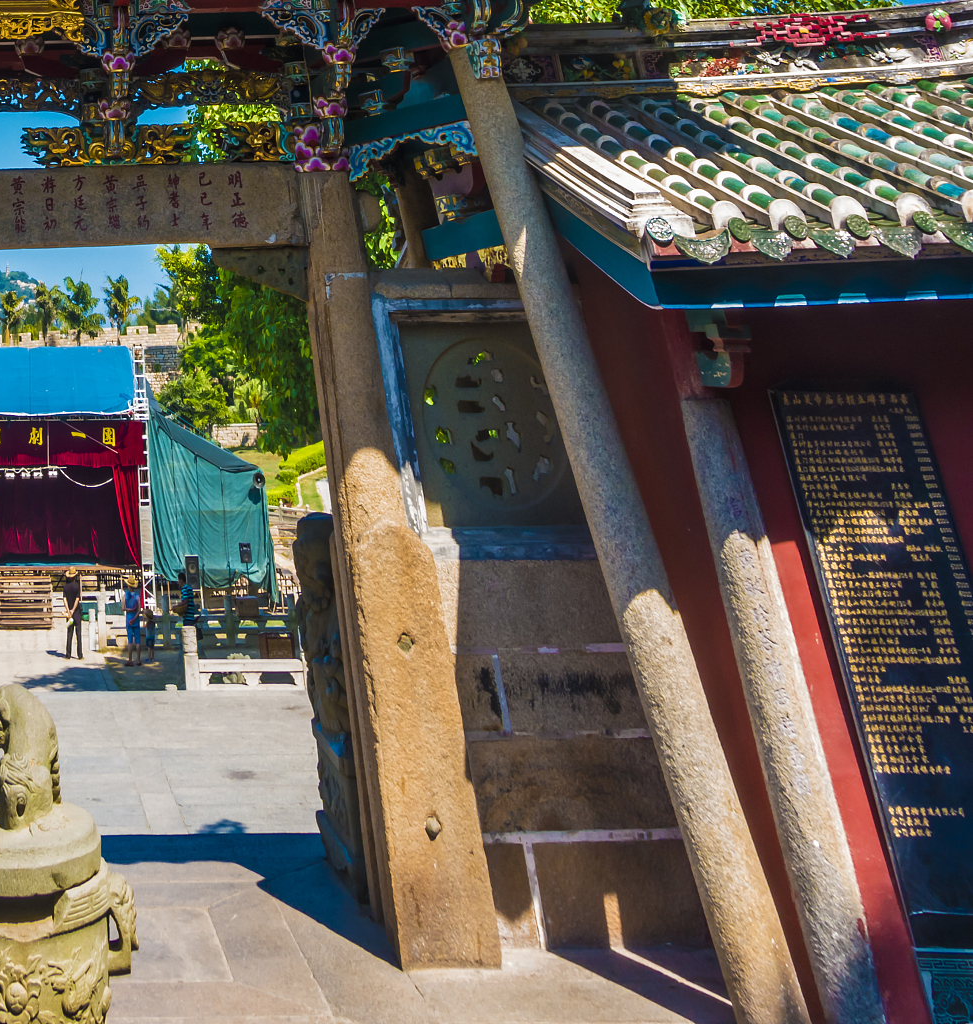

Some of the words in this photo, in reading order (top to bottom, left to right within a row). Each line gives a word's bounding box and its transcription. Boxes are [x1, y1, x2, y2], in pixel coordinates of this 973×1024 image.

[73, 175, 87, 231] 方廷元
[228, 171, 248, 228] 明正德
